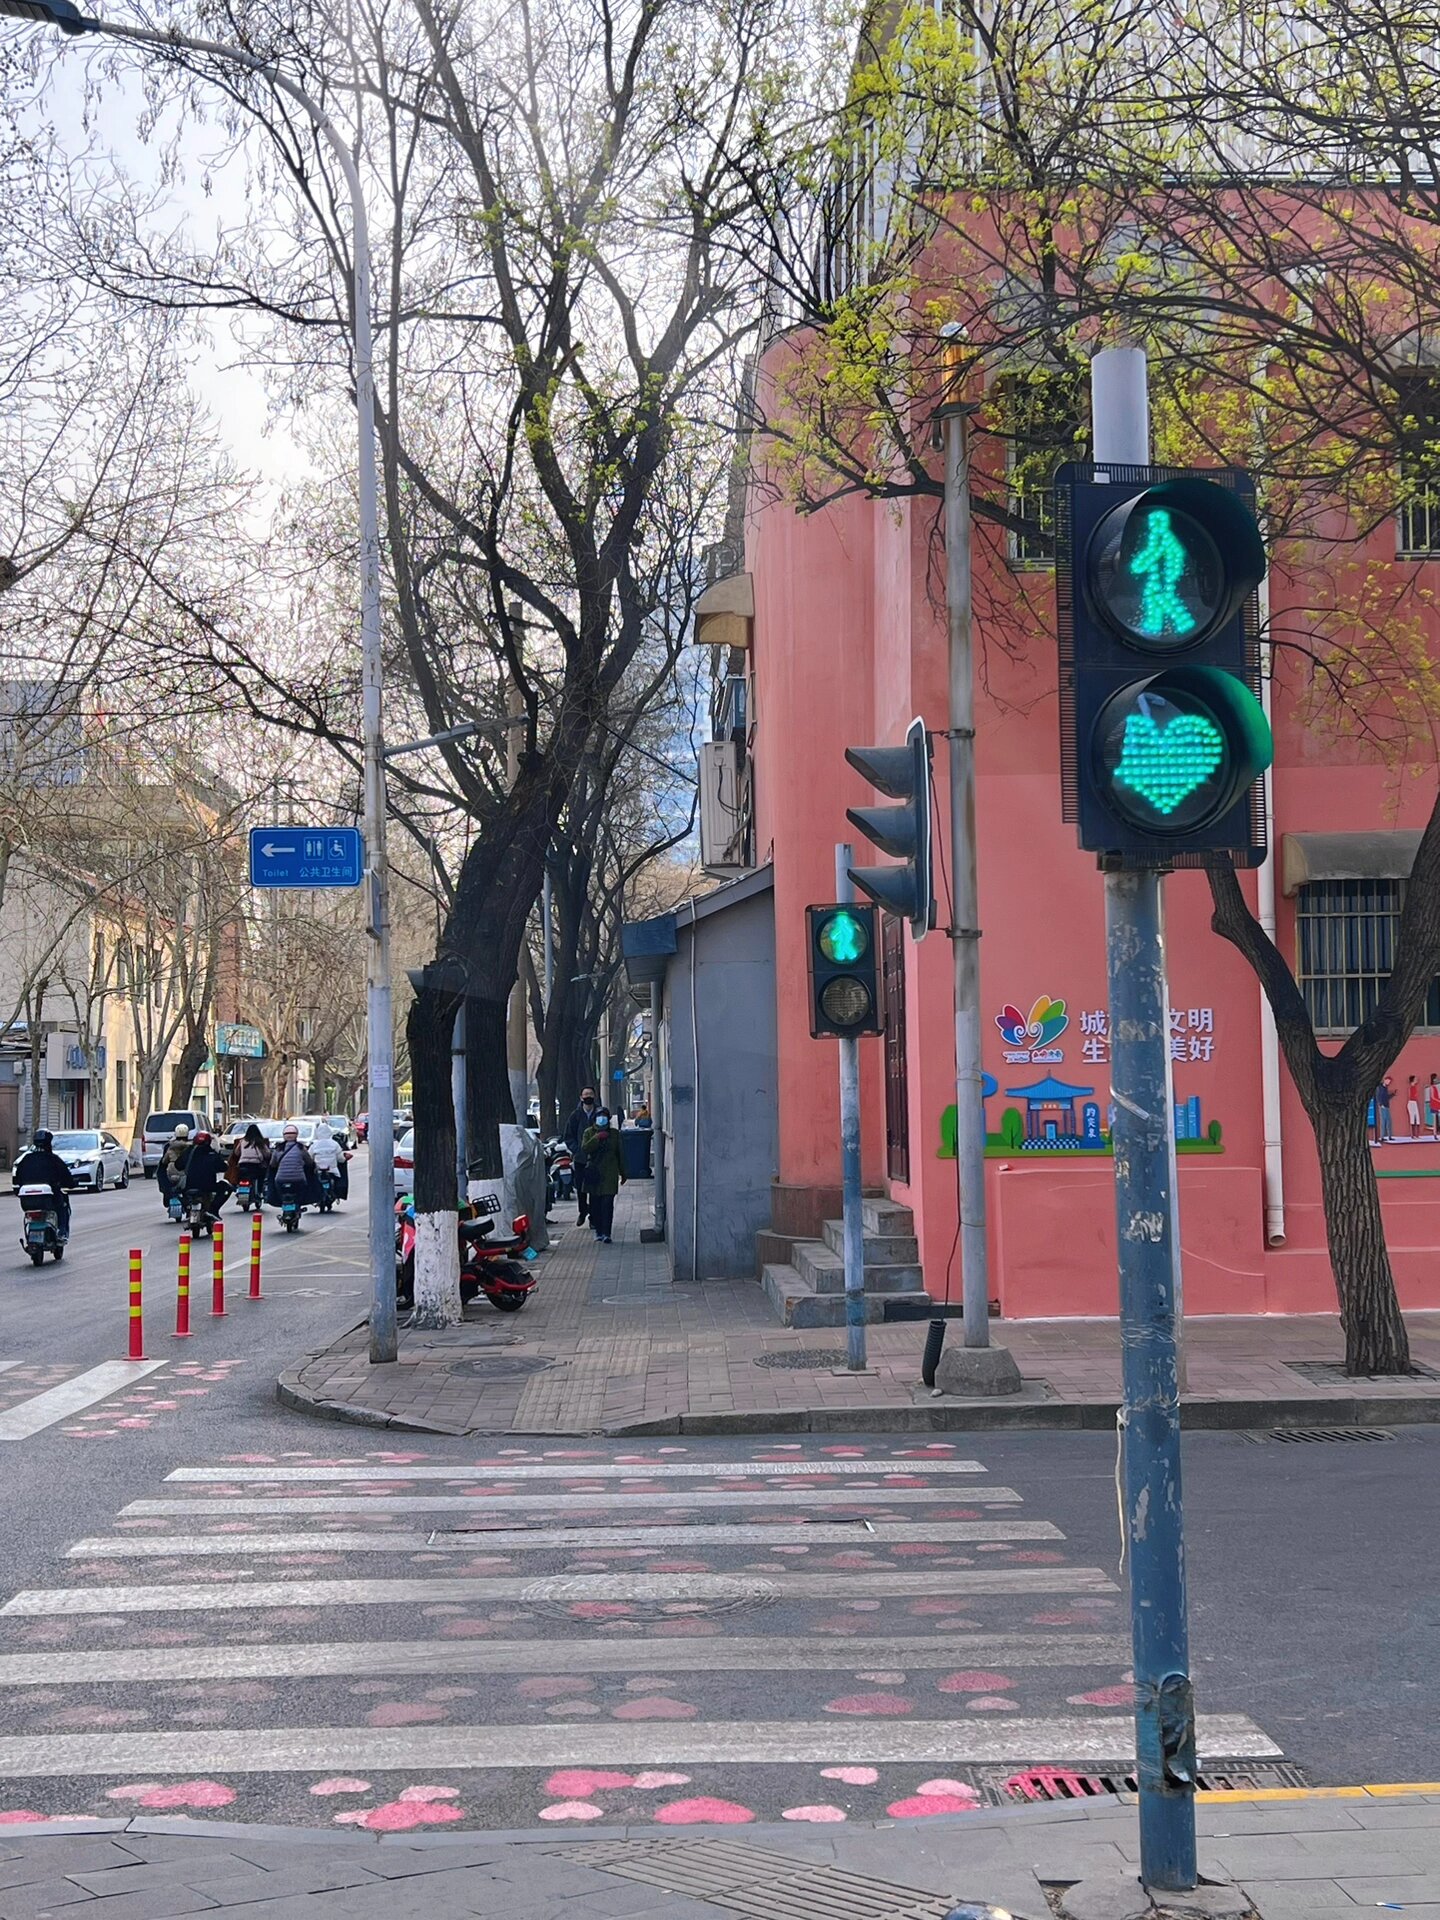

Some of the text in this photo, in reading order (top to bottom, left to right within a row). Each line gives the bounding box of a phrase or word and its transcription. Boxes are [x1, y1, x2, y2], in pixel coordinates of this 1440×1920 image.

[263, 869, 289, 878] Toilet
[299, 866, 353, 878] 公共卫生间
